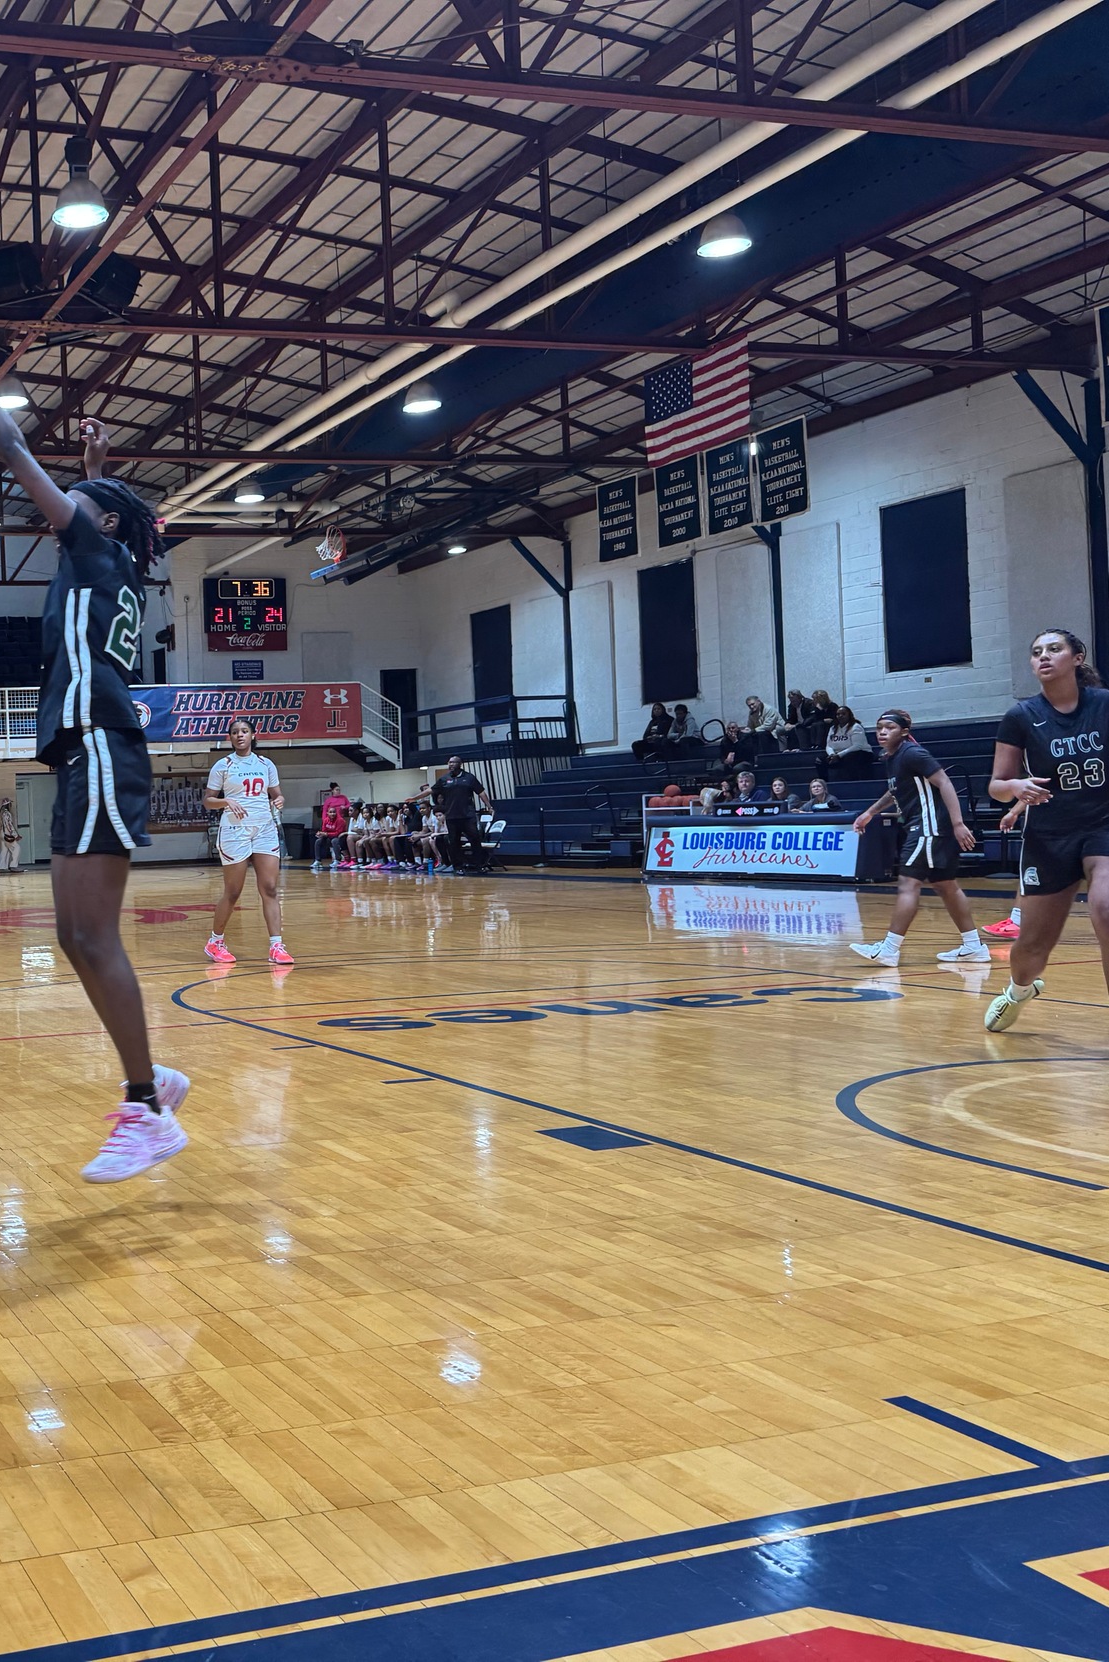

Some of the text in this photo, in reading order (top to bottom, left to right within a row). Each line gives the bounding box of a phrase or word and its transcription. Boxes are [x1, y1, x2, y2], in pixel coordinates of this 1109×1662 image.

[764, 449, 799, 467] BASKETBALL
[712, 465, 744, 482] BASKETBALL
[778, 460, 805, 476] NATIONAL
[664, 481, 692, 497] BASKETBALL
[724, 476, 749, 491] NATIONAL
[766, 473, 802, 493] TOURNAMENT
[675, 494, 697, 508] NATIONAL
[714, 489, 747, 506] TOURNAMENT
[766, 487, 805, 506] ELITE EIGHT
[603, 500, 631, 514] BASKETBALL
[714, 502, 747, 518] ELITE EIGHT
[776, 504, 789, 515] 2011
[663, 509, 694, 526] TOURNAMENT
[602, 526, 633, 540] TOURNAMENT
[672, 527, 686, 538] 2000
[214, 607, 232, 623] 21
[265, 607, 283, 622] 24
[210, 624, 237, 632] HOME
[244, 617, 251, 630] 2
[172, 690, 305, 713] HURRICANE
[173, 714, 299, 737] ATHLTICS
[1050, 731, 1104, 758] GTCC
[1057, 757, 1105, 791] 23
[242, 778, 264, 797] 10
[682, 831, 845, 851] LOUISBURG COLLEGE
[693, 844, 819, 869] Hurricanes
